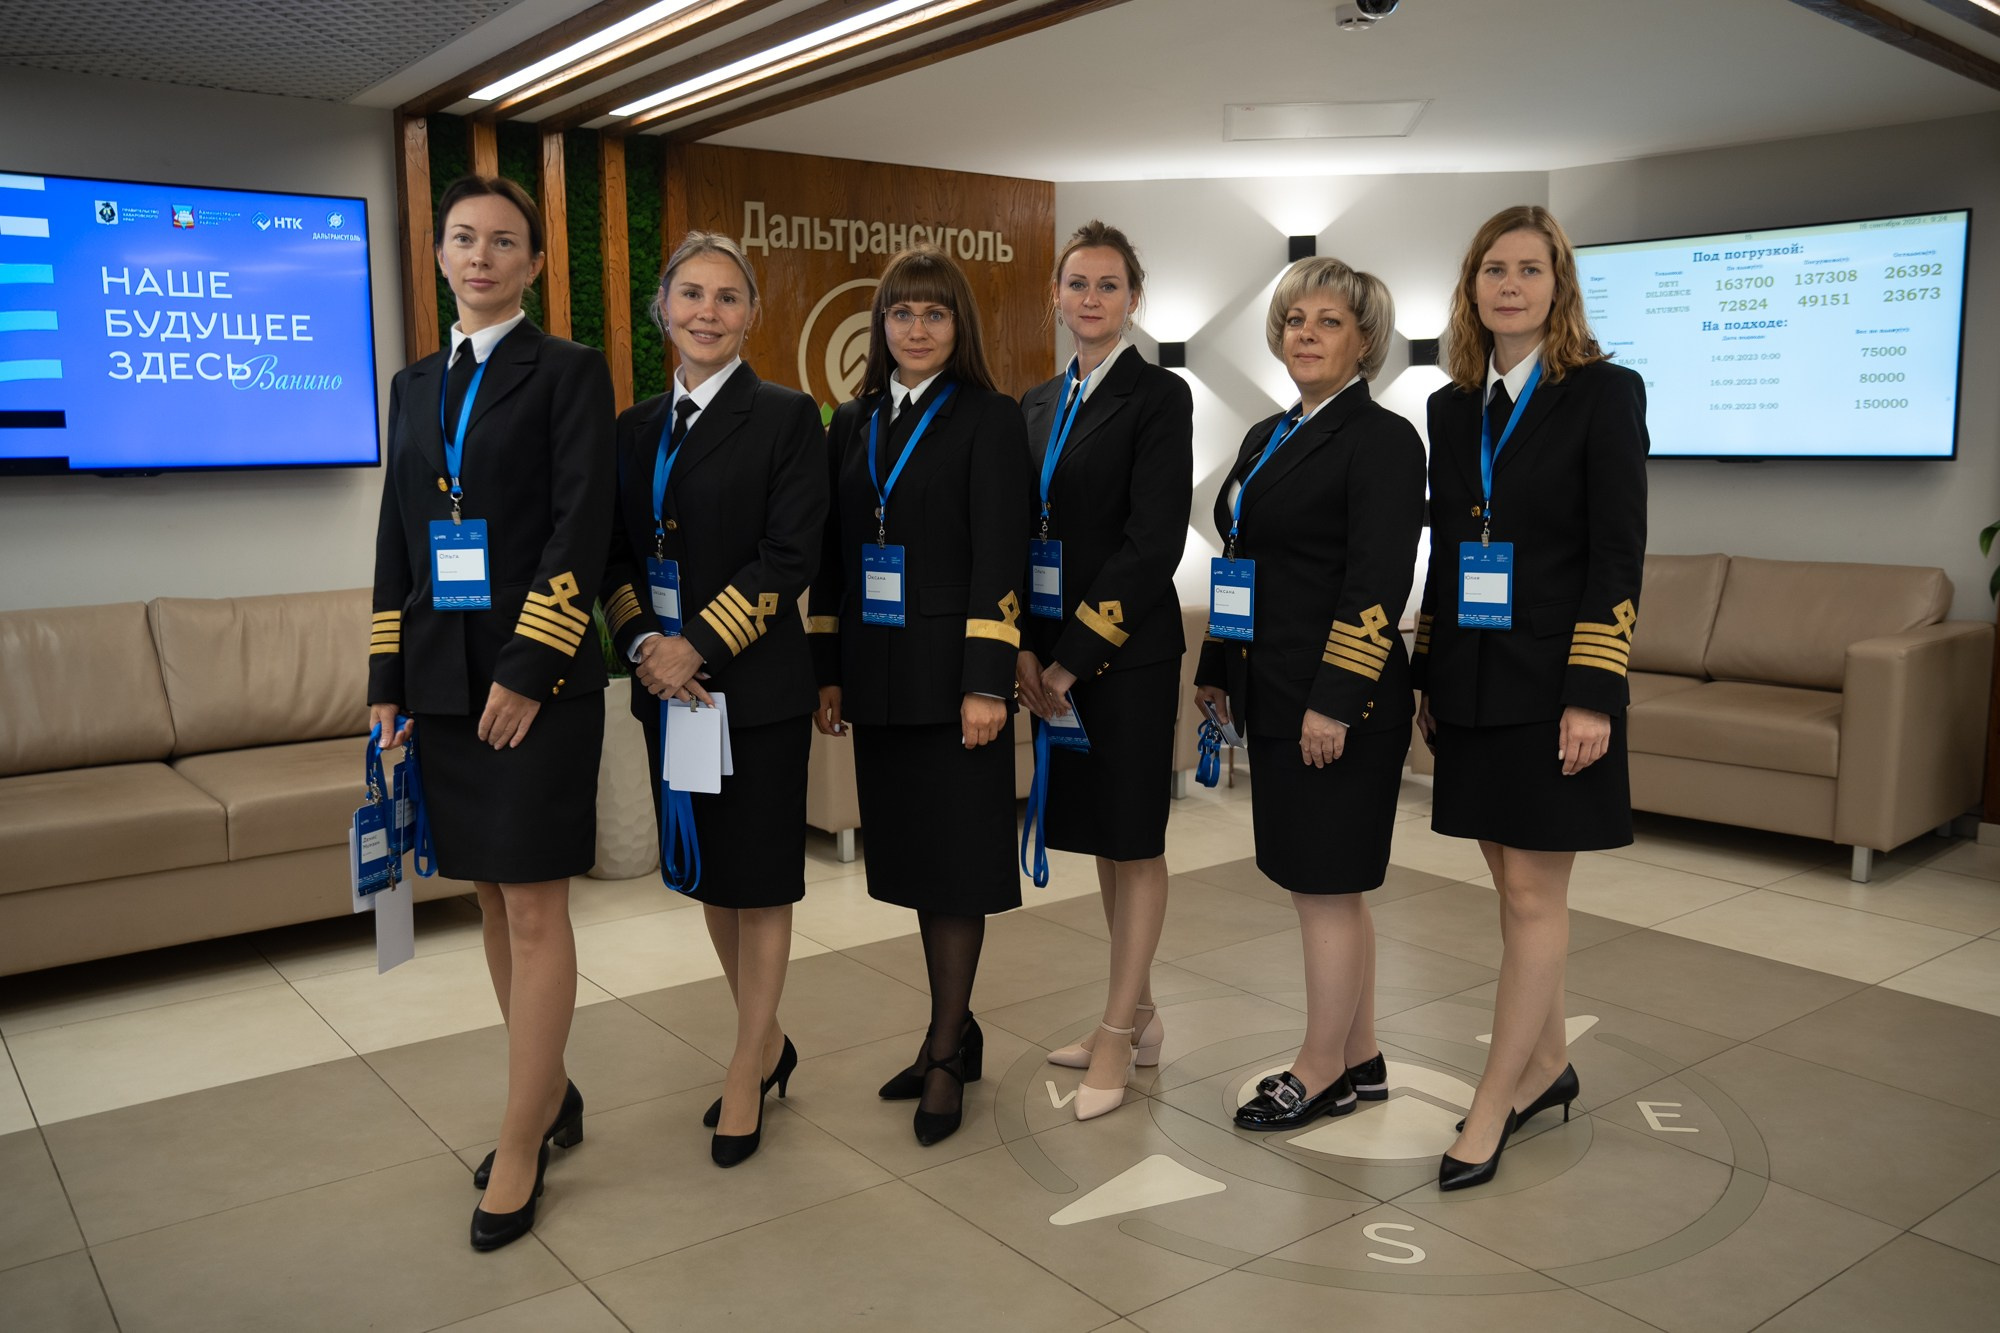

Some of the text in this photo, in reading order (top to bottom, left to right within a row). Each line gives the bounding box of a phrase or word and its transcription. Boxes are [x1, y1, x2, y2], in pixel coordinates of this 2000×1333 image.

[274, 217, 303, 230] НТК
[312, 232, 361, 242] ДАЛЬТРАНСУГОЛЬ
[740, 200, 1013, 263] Дальтрансуголь
[1693, 243, 1804, 262] Под погрузкой:
[1794, 269, 1858, 286] 137308
[1884, 263, 1943, 280] 26392
[101, 265, 233, 299] НАШЕ
[1715, 275, 1774, 291] 163700
[1645, 289, 1692, 298] DILIGENCE
[1797, 293, 1850, 307] 49151
[1883, 286, 1941, 303] 23673
[1718, 298, 1768, 312] 72824
[105, 308, 314, 346] БУДУЩЕЕ
[1702, 319, 1788, 331] На подходе:
[1711, 352, 1781, 362] 14.09.2023 0:00
[1861, 346, 1907, 357] 75000
[108, 350, 343, 391] ЗДЕСЬ Ванино
[1859, 372, 1905, 383] 80000
[1710, 377, 1780, 386] 16.09.2023 0:00
[1709, 402, 1779, 411] 16.09.2023 9:00
[1855, 398, 1909, 409] 150000
[1636, 1101, 1700, 1133] E
[1362, 1222, 1426, 1264] S
